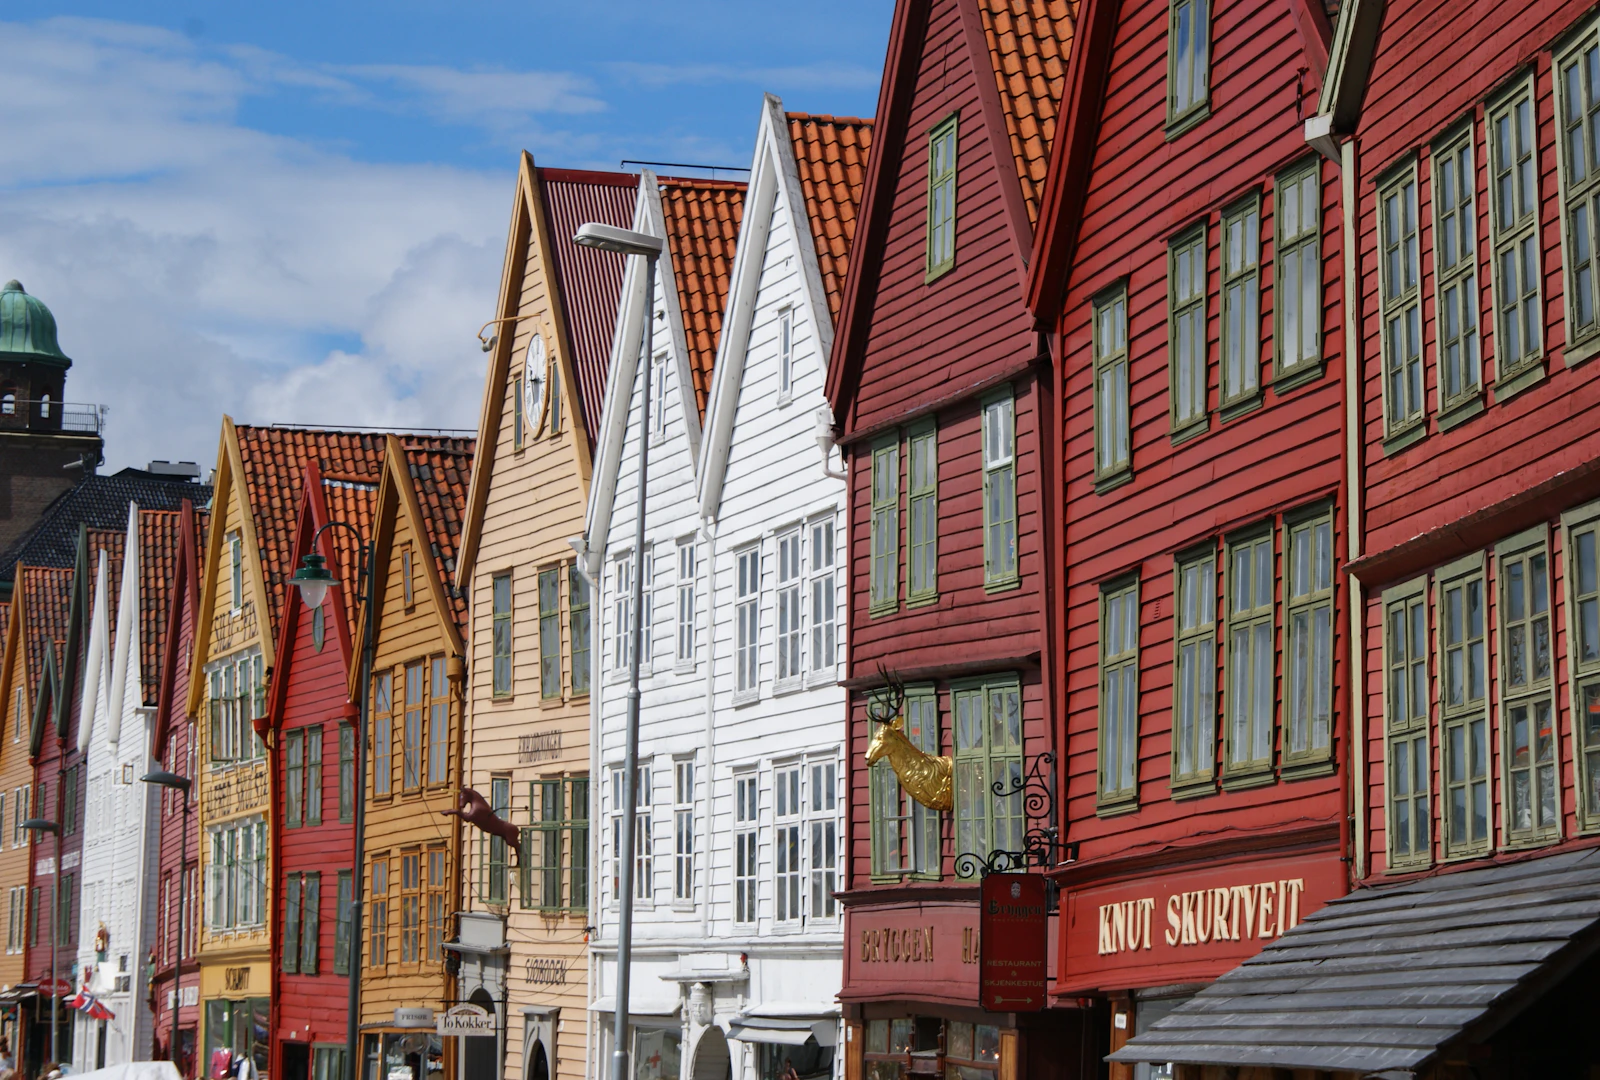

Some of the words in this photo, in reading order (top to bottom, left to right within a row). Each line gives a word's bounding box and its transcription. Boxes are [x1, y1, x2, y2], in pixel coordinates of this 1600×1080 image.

[1098, 898, 1155, 955] KNUT
[1165, 878, 1304, 947] SKURTVEIT
[861, 926, 934, 962] BRYGGEN
[441, 1015, 454, 1028] To
[455, 1016, 491, 1029] Kokker
